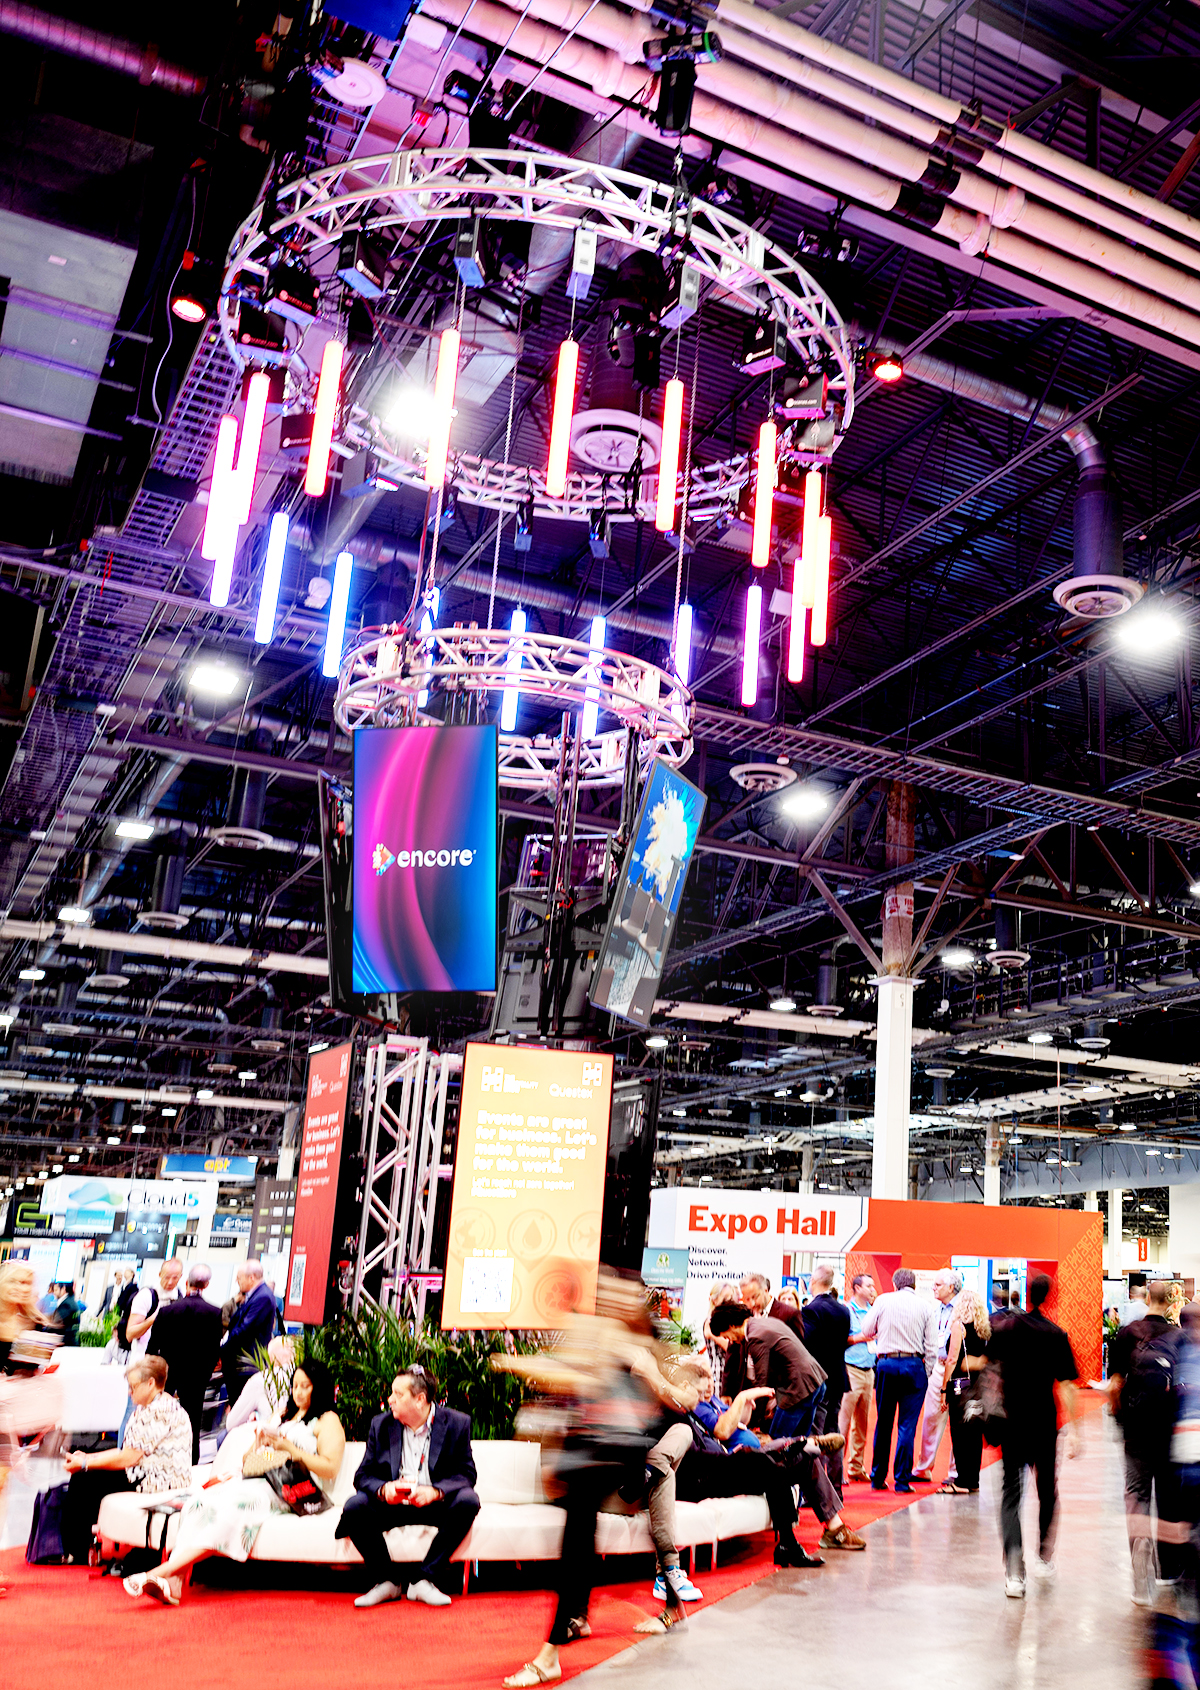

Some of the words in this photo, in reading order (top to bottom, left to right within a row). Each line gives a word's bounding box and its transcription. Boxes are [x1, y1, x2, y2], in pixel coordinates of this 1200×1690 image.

[397, 848, 474, 868] encore
[477, 1109, 524, 1126] Events
[526, 1115, 550, 1128] are
[552, 1116, 588, 1131] great
[475, 1125, 497, 1140] for
[498, 1126, 562, 1144] business.
[565, 1130, 598, 1146] Let's
[474, 1141, 513, 1157] make
[515, 1142, 551, 1158] them
[553, 1146, 586, 1162] good
[472, 1155, 494, 1171] for
[495, 1156, 520, 1172] the
[521, 1159, 564, 1174] world.
[128, 1188, 199, 1207] Cloud5
[688, 1204, 768, 1240] Expo
[776, 1208, 836, 1237] Hall
[688, 1245, 728, 1255] Discover.
[688, 1258, 727, 1268] Network.
[686, 1270, 710, 1280] Drive
